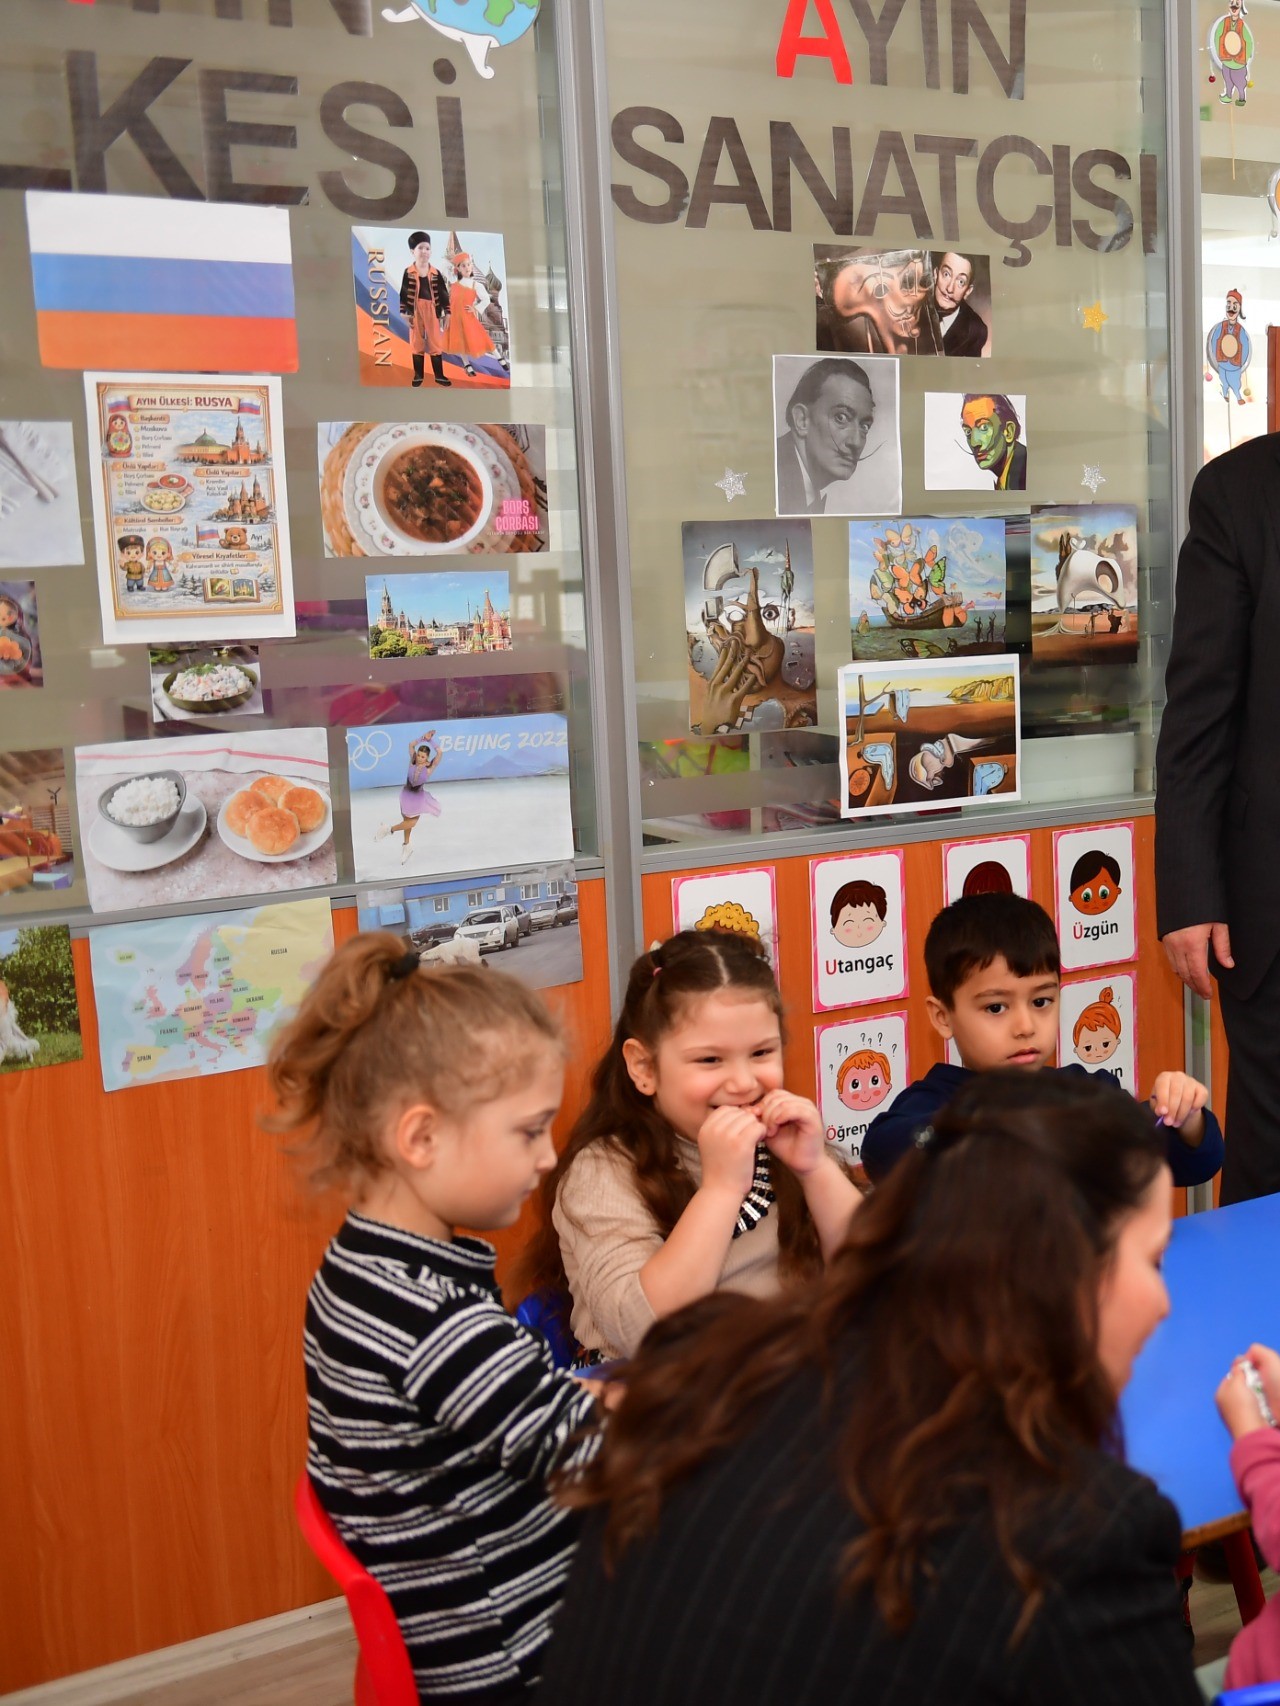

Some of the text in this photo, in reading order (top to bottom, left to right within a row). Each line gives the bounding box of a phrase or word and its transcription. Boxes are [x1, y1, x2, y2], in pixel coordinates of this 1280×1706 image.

[610, 106, 1158, 267] SANATÇISI
[367, 247, 394, 367] RUSSIAN
[136, 396, 233, 407] AYIN ÜLKESİ: RUSYA
[502, 500, 530, 516] BORŞ
[438, 731, 568, 756] BEIJING 2022
[1073, 920, 1118, 941] Üzgün
[270, 947, 288, 955] RUSSIA
[825, 954, 894, 975] Utangaç
[159, 1027, 178, 1035] FRANCE
[137, 1054, 152, 1062] SPAIN
